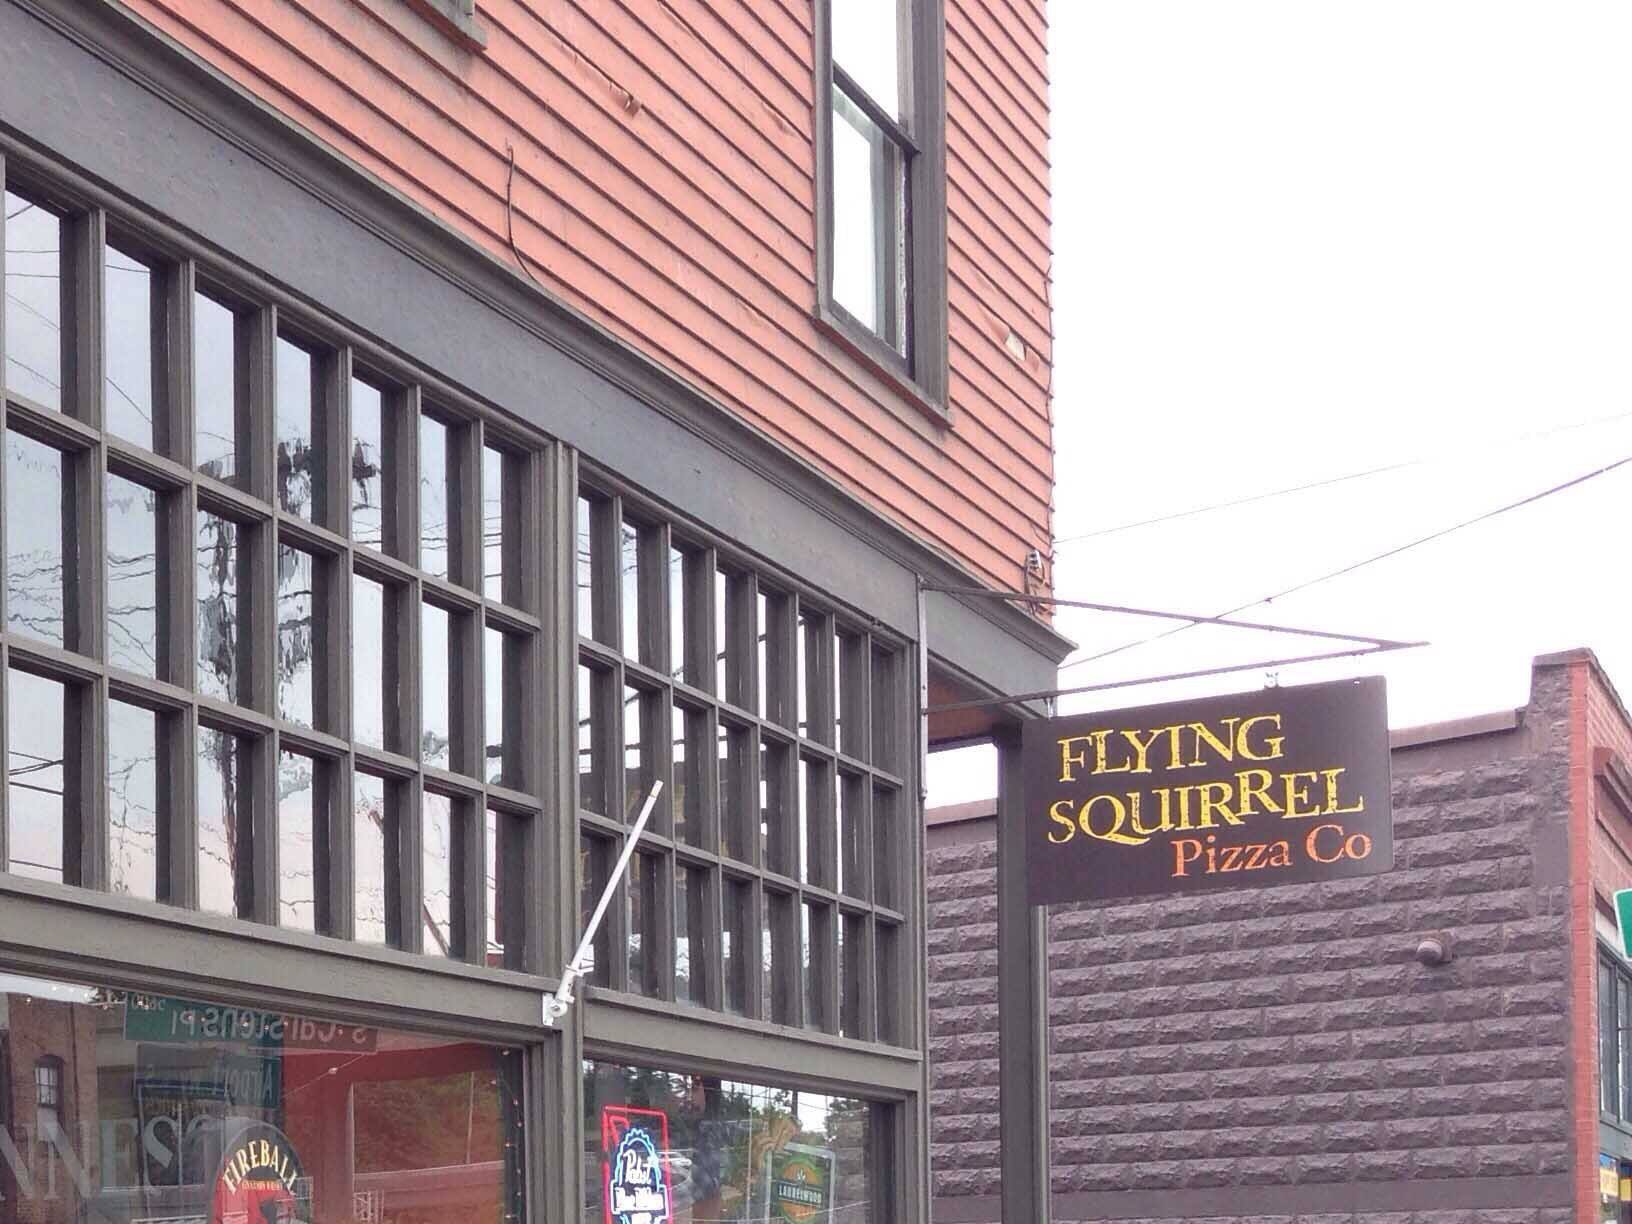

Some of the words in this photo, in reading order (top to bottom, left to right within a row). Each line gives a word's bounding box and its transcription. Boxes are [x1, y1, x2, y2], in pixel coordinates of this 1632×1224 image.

[1056, 713, 1286, 783] FLYING
[1047, 767, 1365, 846] SQUIRREL
[1170, 837, 1292, 879] Pizza
[1305, 824, 1372, 864] Co
[223, 1139, 298, 1195] FIREBALL
